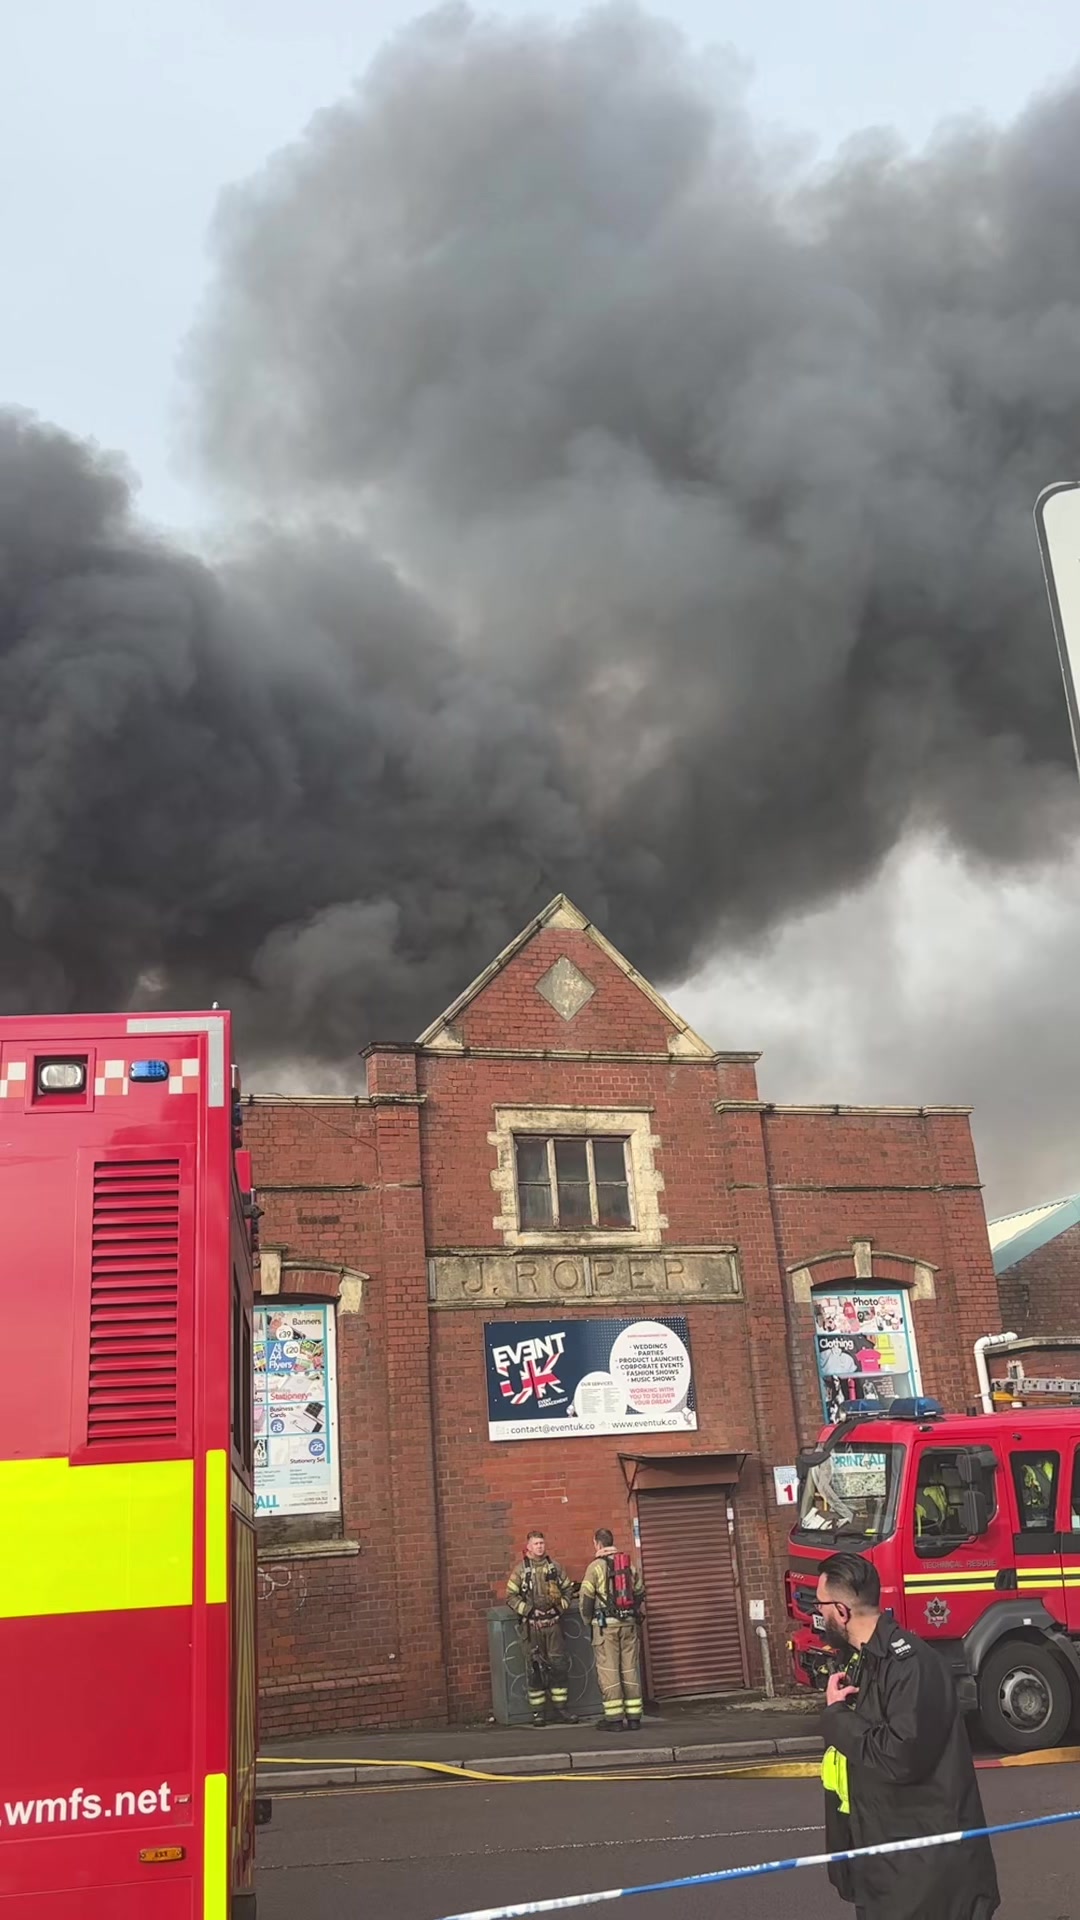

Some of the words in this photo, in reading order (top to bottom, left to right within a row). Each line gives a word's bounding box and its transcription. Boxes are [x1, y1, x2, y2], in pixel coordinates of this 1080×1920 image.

[292, 1318, 322, 1326] Banners
[492, 1332, 566, 1366] EVENT
[820, 1338, 854, 1350] Clothing
[269, 1361, 293, 1371] Flyers
[270, 1392, 308, 1401] Stationery
[510, 1423, 595, 1434] contact@eventuk.co
[611, 1419, 678, 1429] www.eventuk.co
[784, 1484, 794, 1501] 1
[966, 1559, 997, 1568] RESCUE
